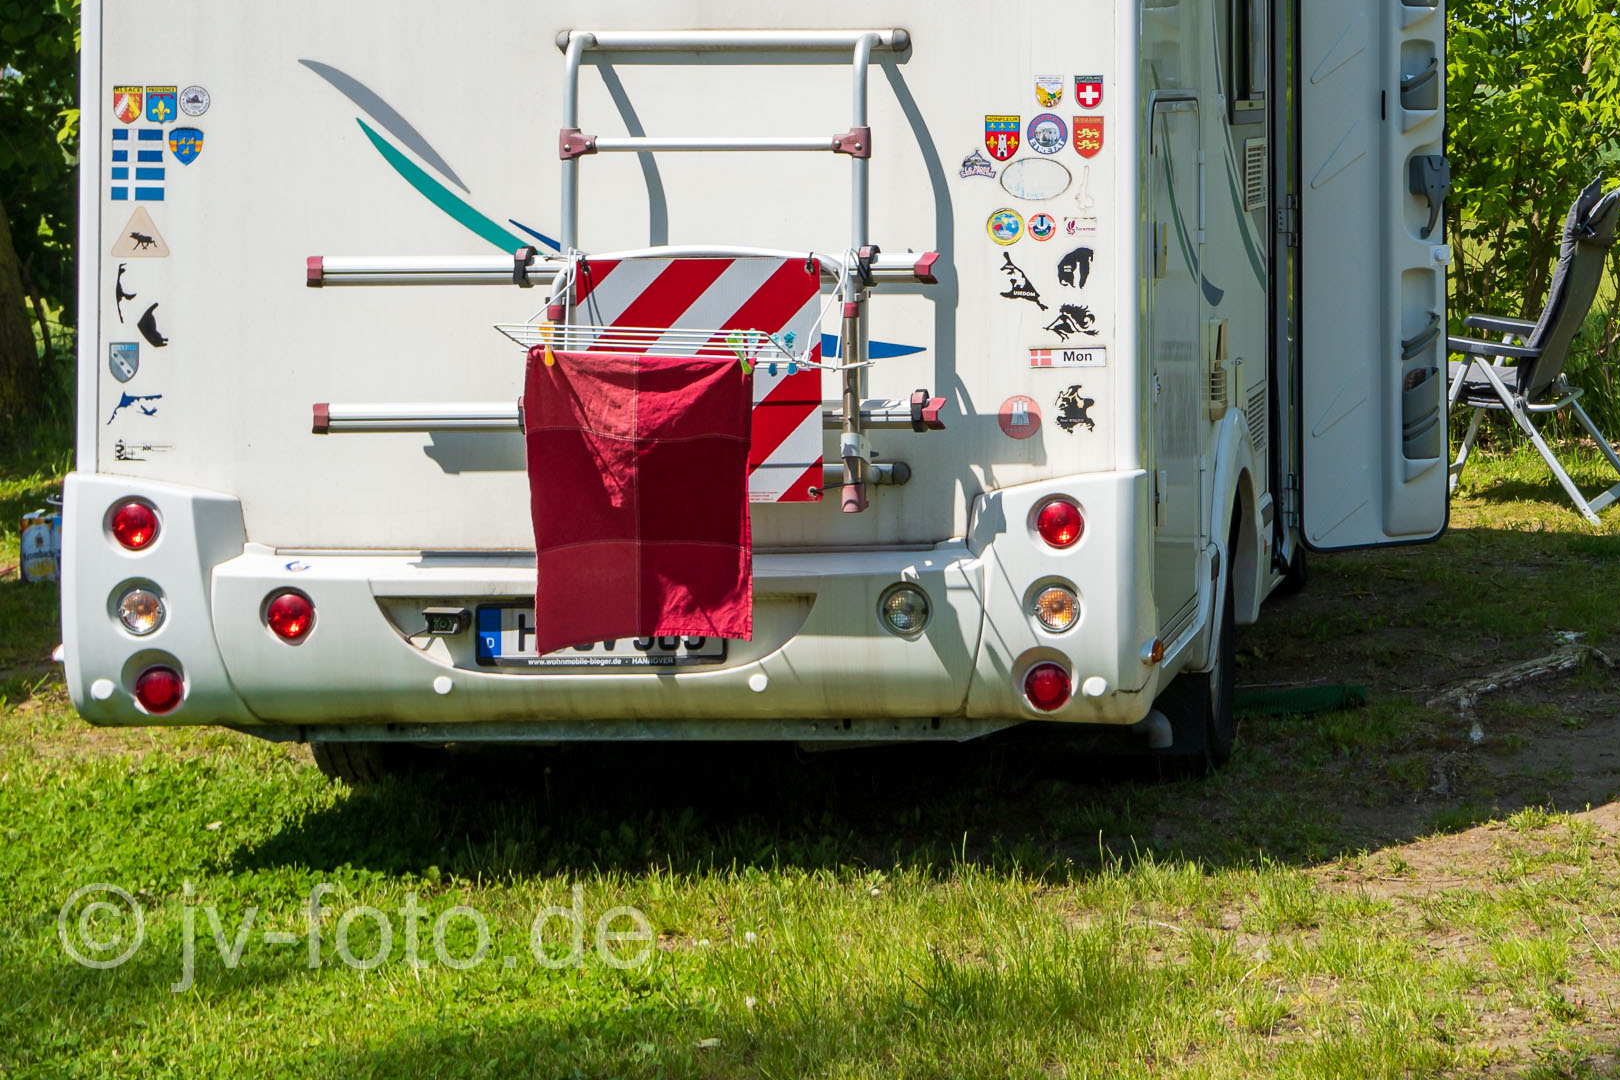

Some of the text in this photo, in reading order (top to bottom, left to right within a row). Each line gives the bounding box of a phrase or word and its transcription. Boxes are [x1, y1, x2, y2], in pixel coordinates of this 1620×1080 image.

[1063, 351, 1093, 362] Møn
[486, 637, 495, 649] D
[632, 657, 674, 665] HANNOVER
